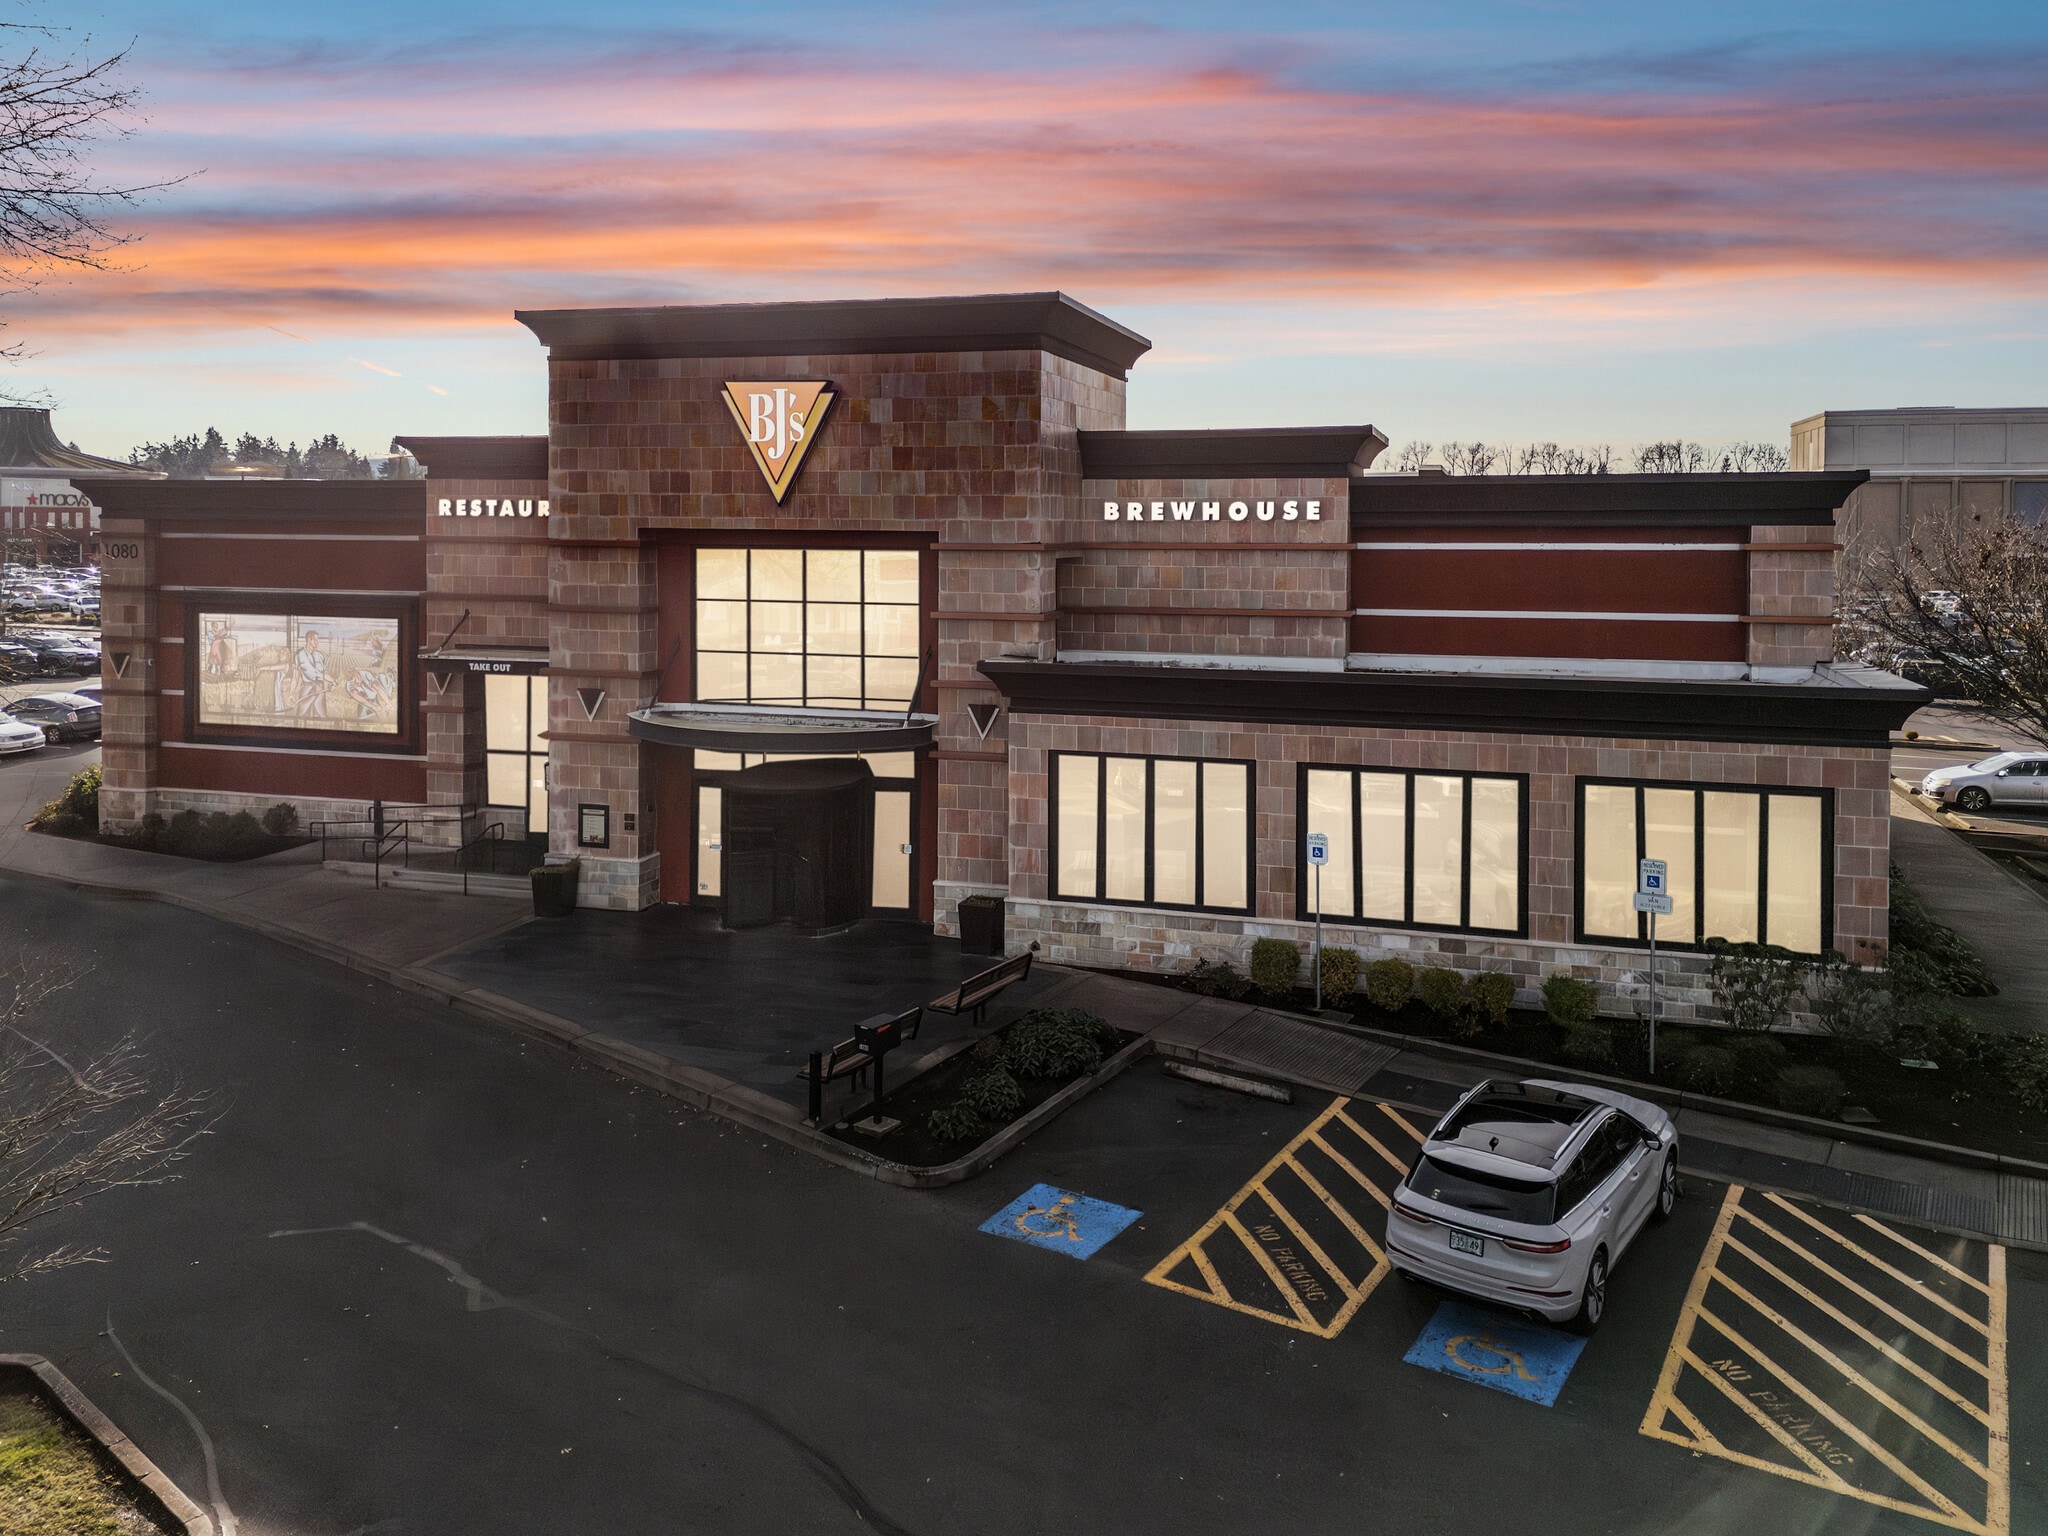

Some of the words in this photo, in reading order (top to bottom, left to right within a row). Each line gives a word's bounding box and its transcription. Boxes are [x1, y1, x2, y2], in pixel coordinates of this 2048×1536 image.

[748, 388, 804, 459] BJ's
[438, 499, 550, 517] RESTAUR
[1103, 500, 1321, 521] BREWHOUSE
[104, 543, 139, 559] 1080
[469, 662, 490, 671] TAKE
[492, 663, 511, 672] OUT
[1253, 1225, 1280, 1240] NO
[1271, 1247, 1328, 1301] PARKING
[1708, 1359, 1752, 1381] NO
[1750, 1391, 1854, 1465] PARKING
